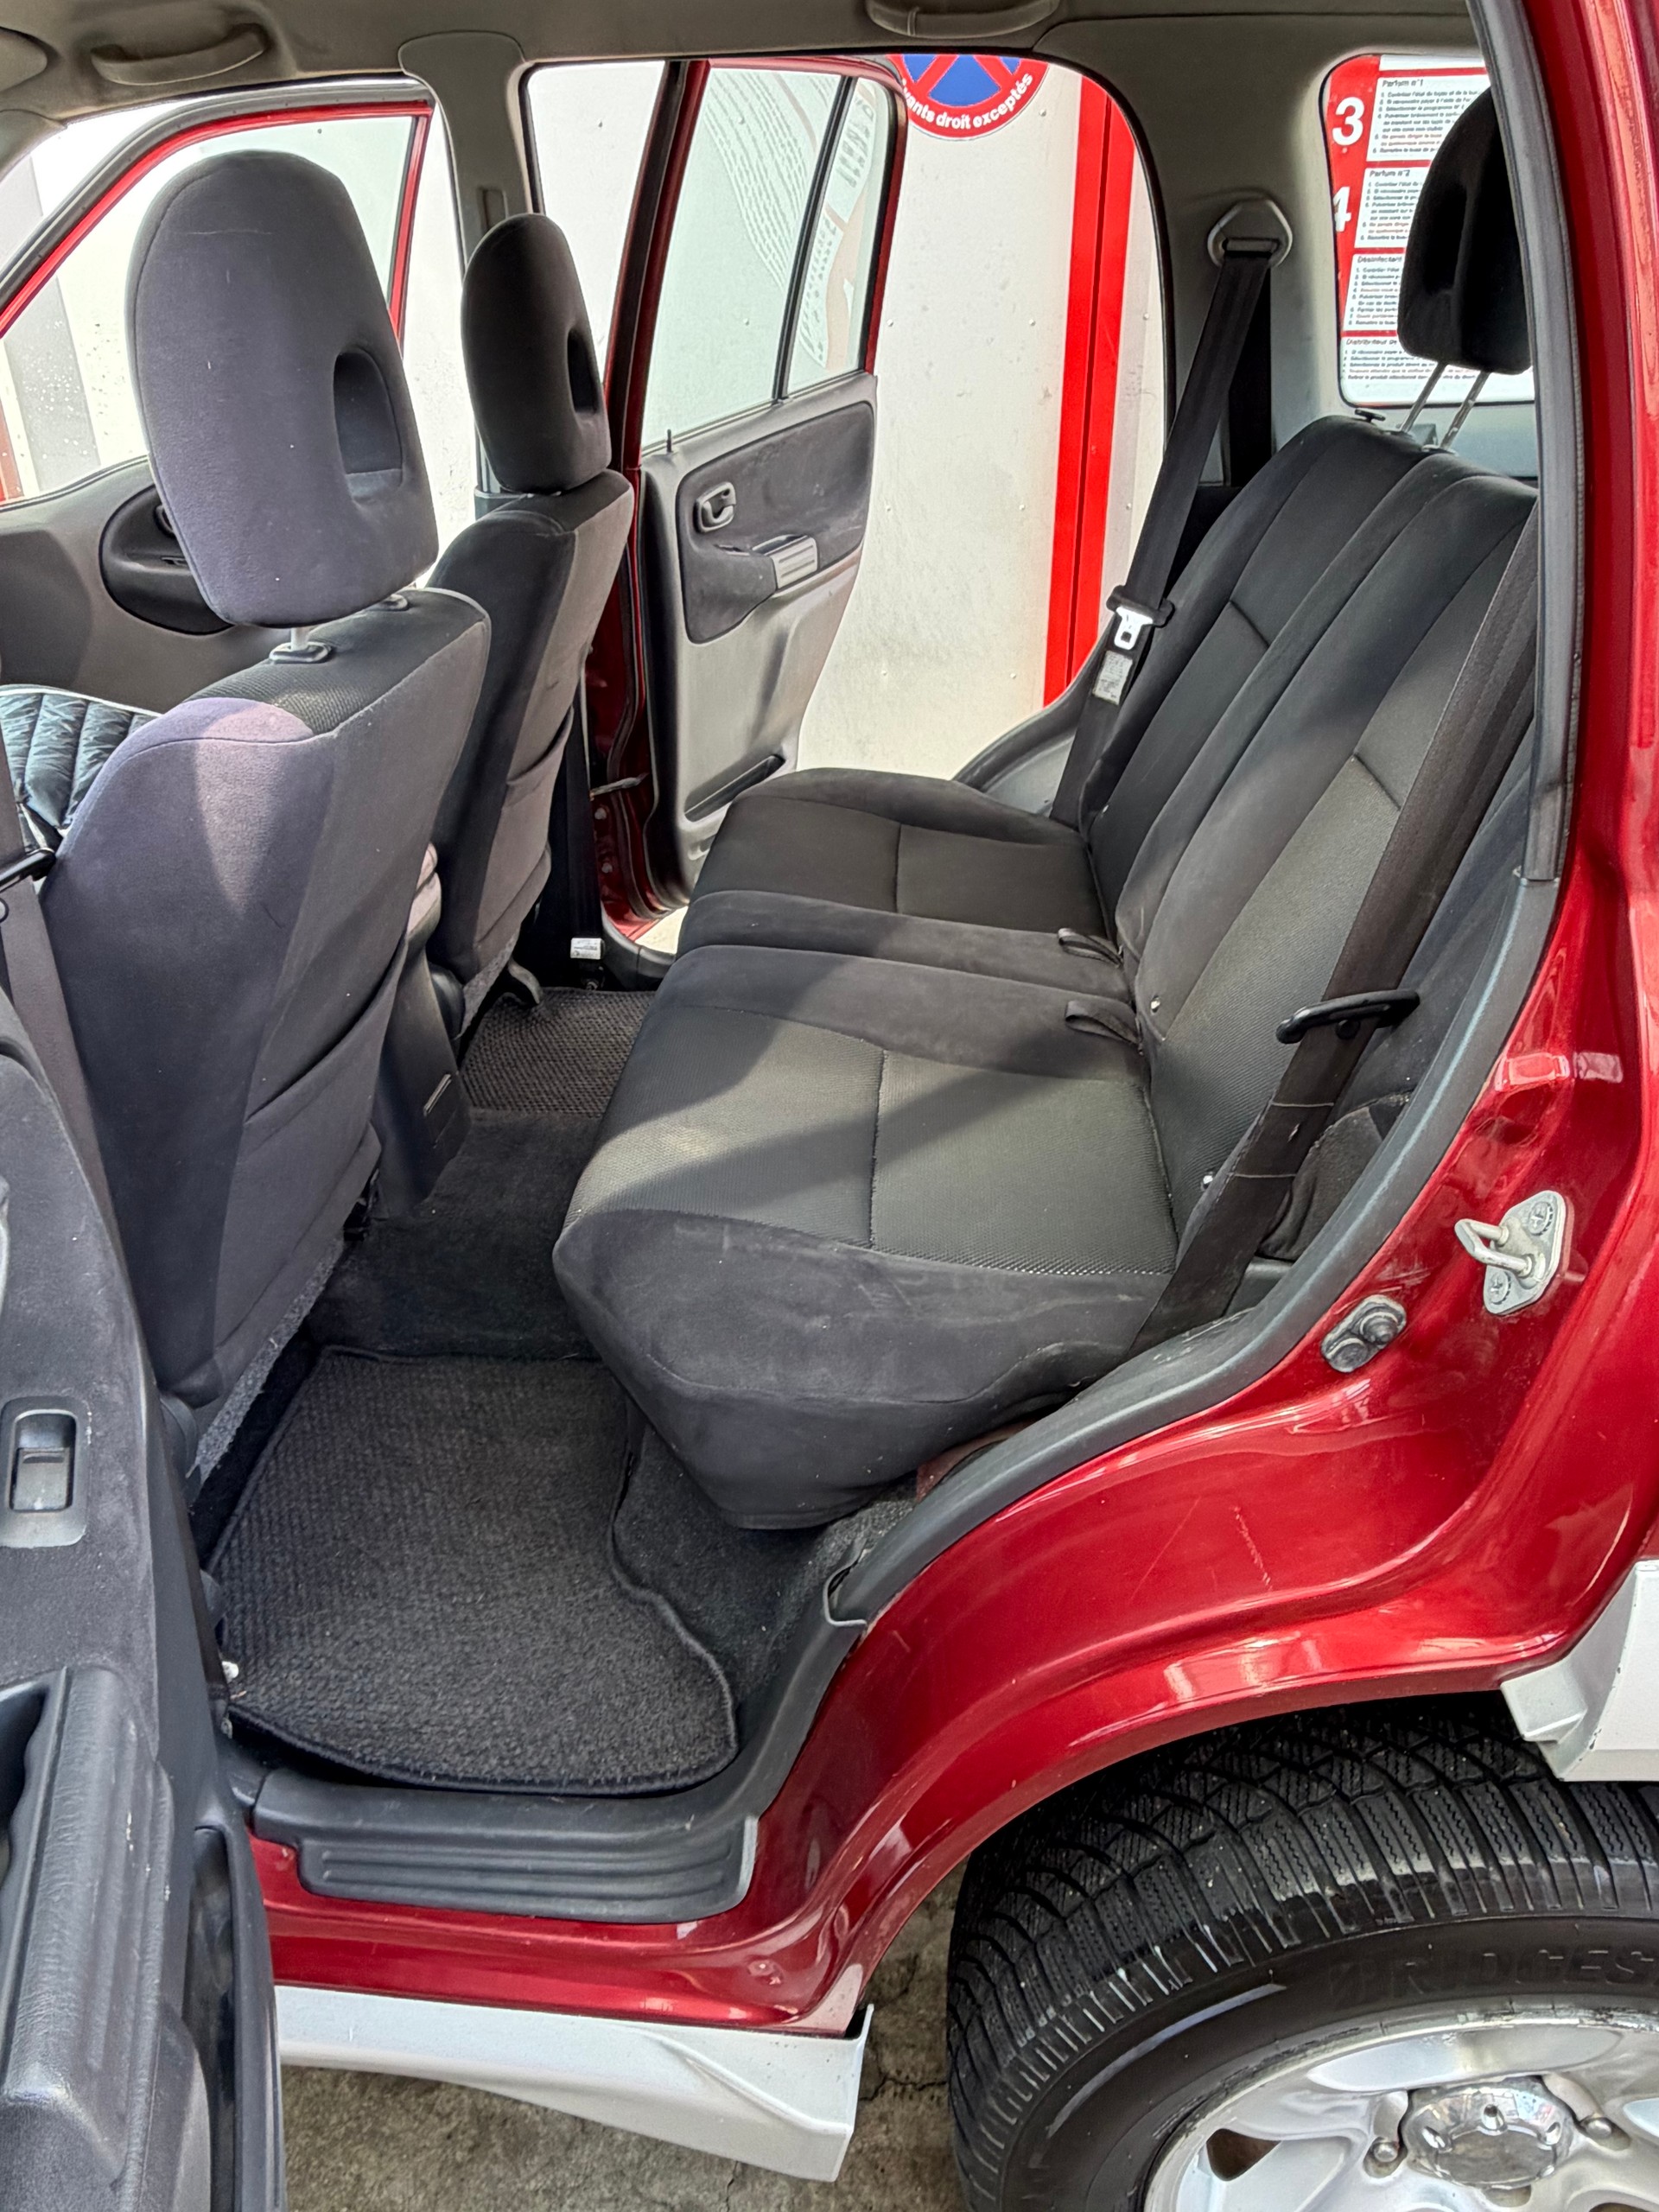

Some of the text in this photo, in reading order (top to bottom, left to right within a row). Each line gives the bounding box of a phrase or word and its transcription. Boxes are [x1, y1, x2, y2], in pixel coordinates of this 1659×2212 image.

[902, 73, 1033, 130] ants droit exceptés
[1332, 96, 1364, 146] 3
[1332, 186, 1351, 232] 4
